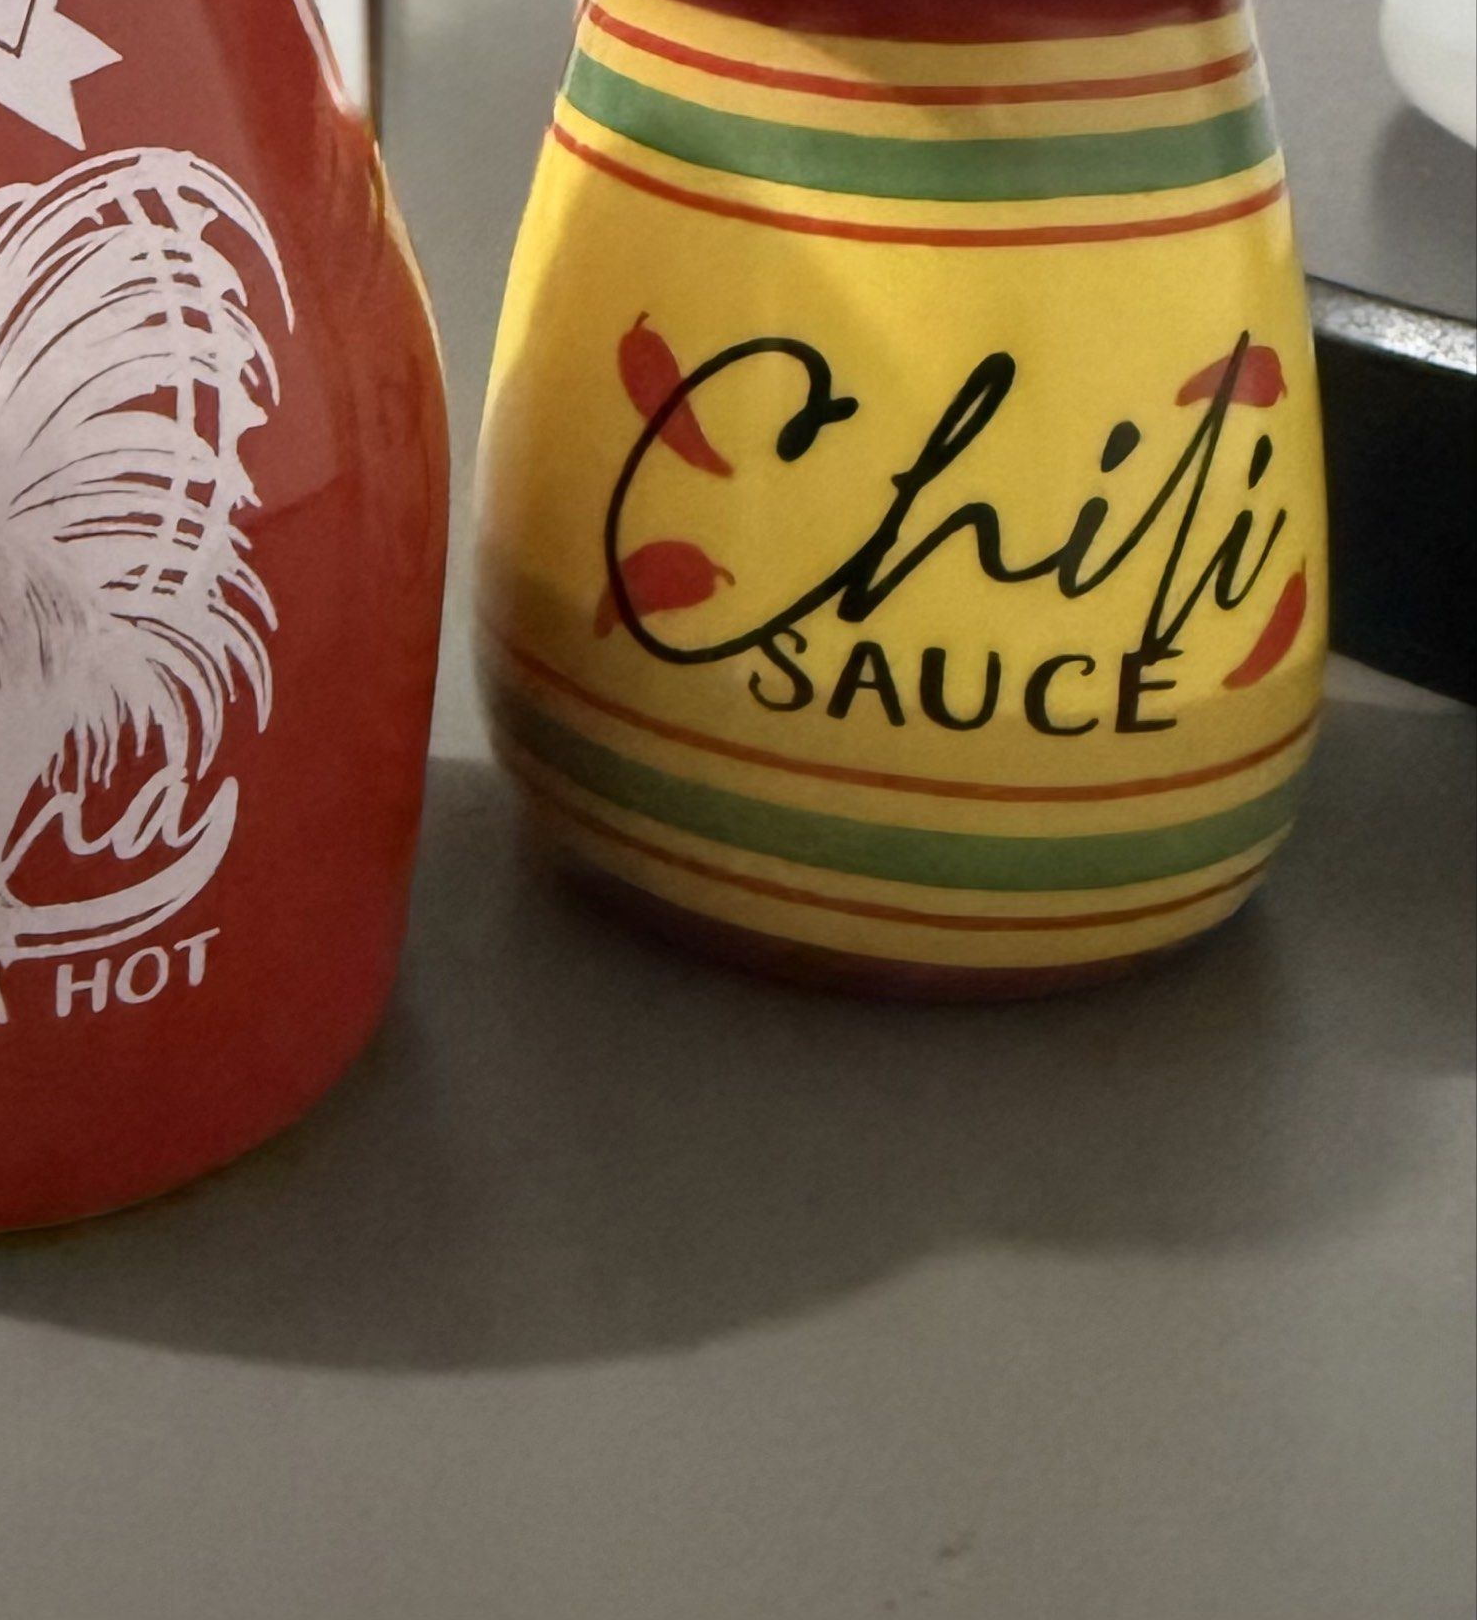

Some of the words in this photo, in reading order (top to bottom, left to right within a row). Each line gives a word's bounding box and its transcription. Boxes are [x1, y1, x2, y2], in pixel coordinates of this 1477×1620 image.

[605, 309, 1288, 666] Chili
[748, 627, 1185, 737] SAUCE
[54, 926, 222, 1018] HOT
